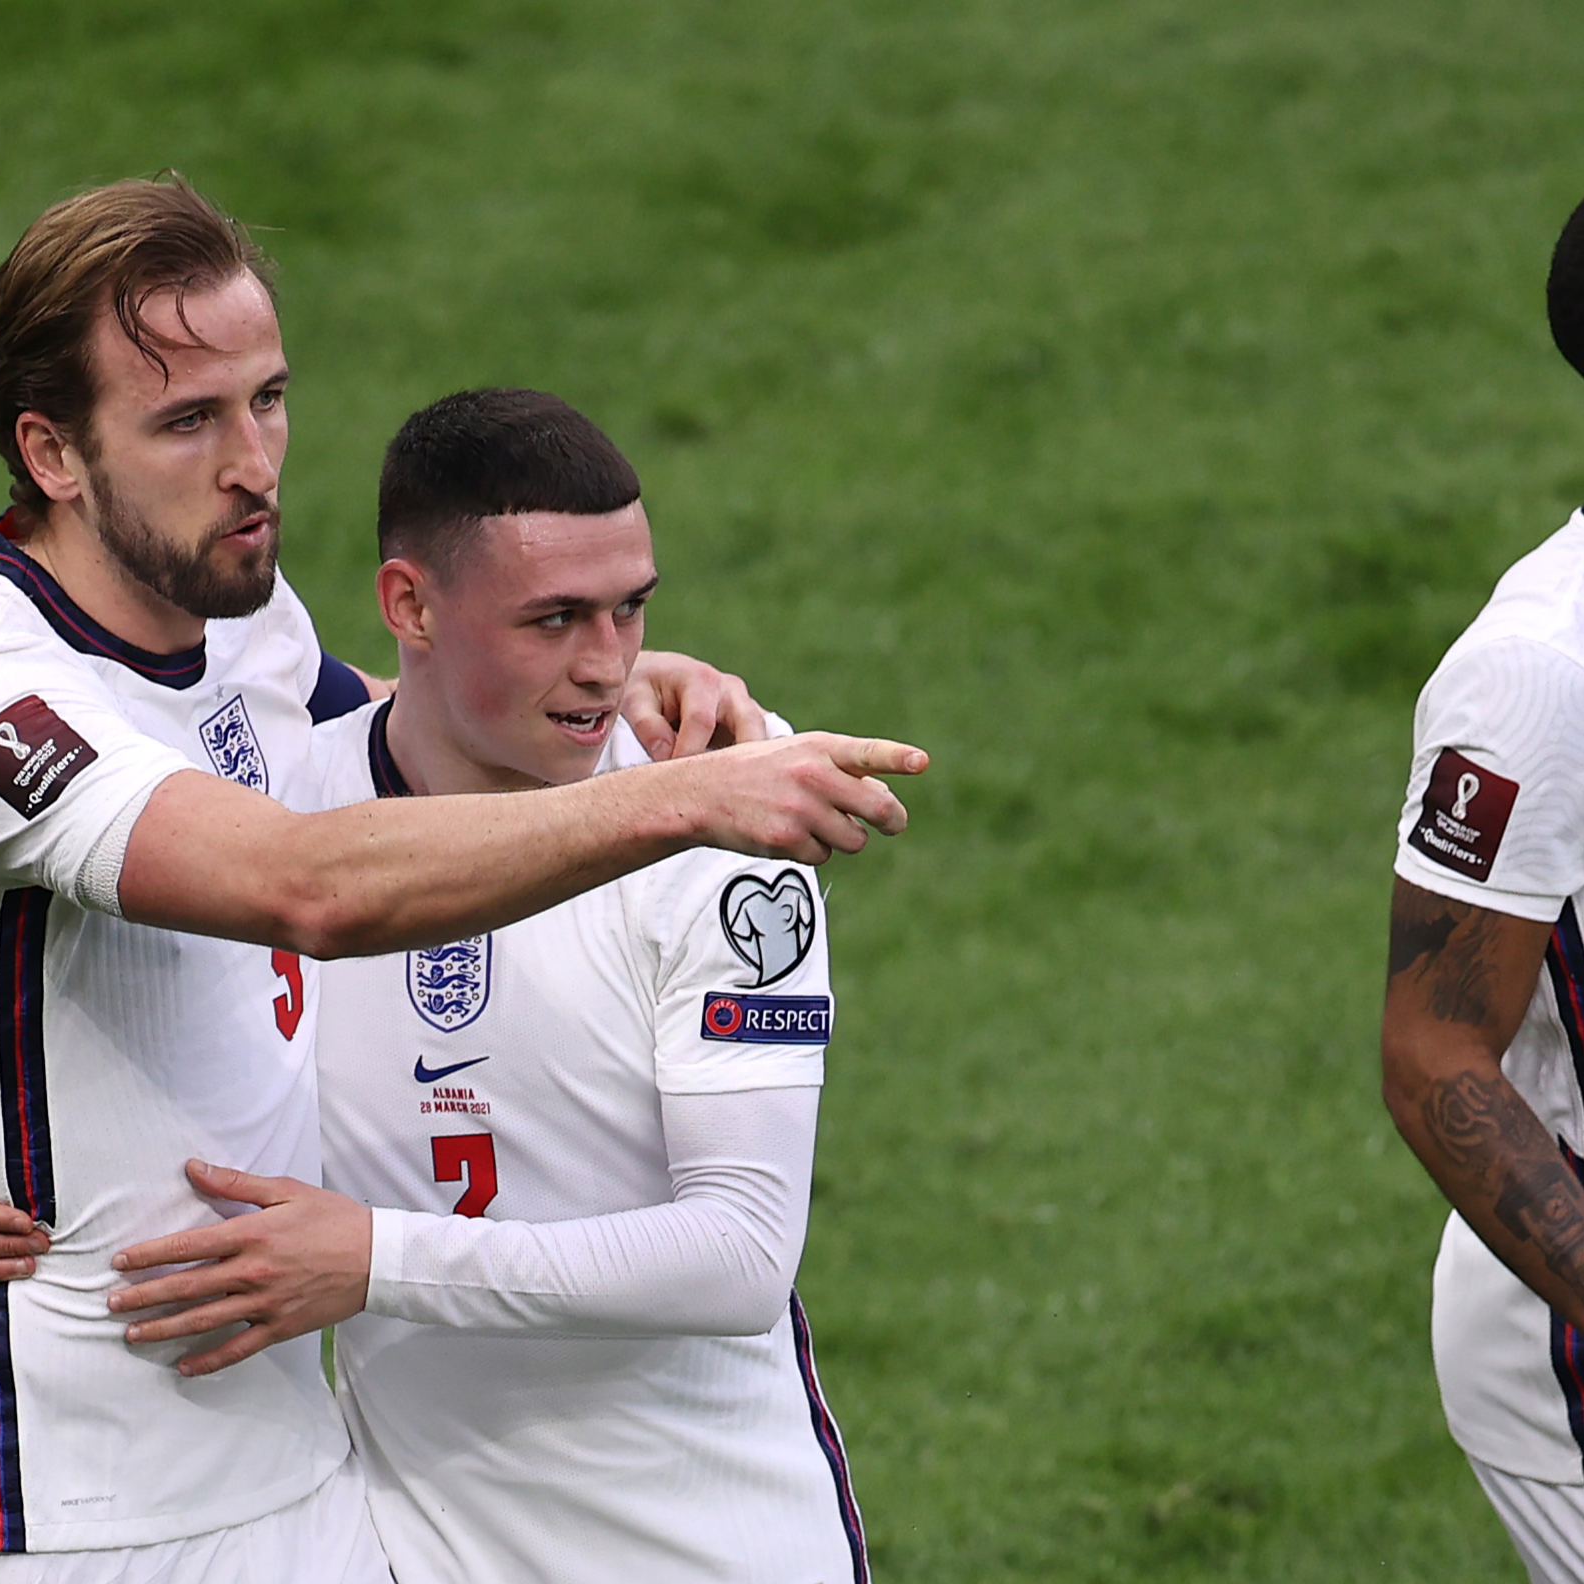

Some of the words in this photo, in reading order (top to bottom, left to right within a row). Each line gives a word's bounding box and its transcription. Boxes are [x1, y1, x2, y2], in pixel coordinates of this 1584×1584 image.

[29, 751, 76, 804] Qualifiers
[1424, 827, 1477, 864] Qualifiers
[714, 1000, 736, 1011] UEFA
[745, 1008, 829, 1031] RESPECT
[433, 1087, 475, 1100] ALBANIA
[419, 1101, 432, 1114] 28
[434, 1101, 469, 1113] MARCH
[470, 1102, 491, 1115] 2021
